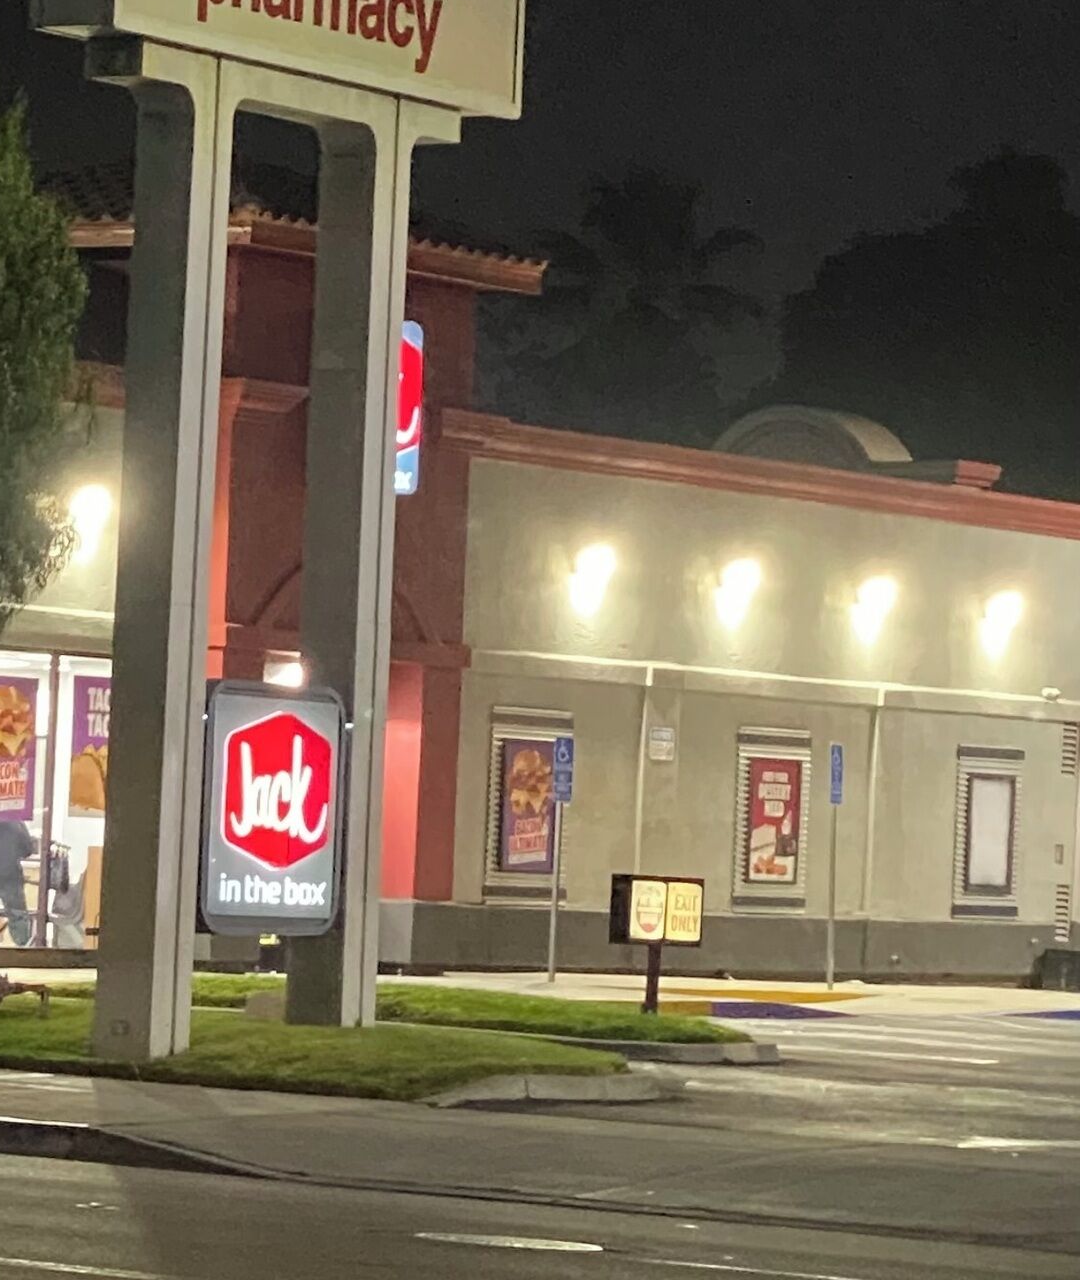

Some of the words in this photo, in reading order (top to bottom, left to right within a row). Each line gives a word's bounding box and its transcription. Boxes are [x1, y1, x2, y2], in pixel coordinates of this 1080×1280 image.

[88, 687, 111, 712] TAC
[87, 713, 110, 737] TAC
[230, 734, 328, 844] Jack
[219, 873, 241, 903] in
[244, 874, 282, 904] the
[284, 877, 327, 906] box
[674, 894, 698, 912] EXIT
[671, 914, 699, 932] ONLY
